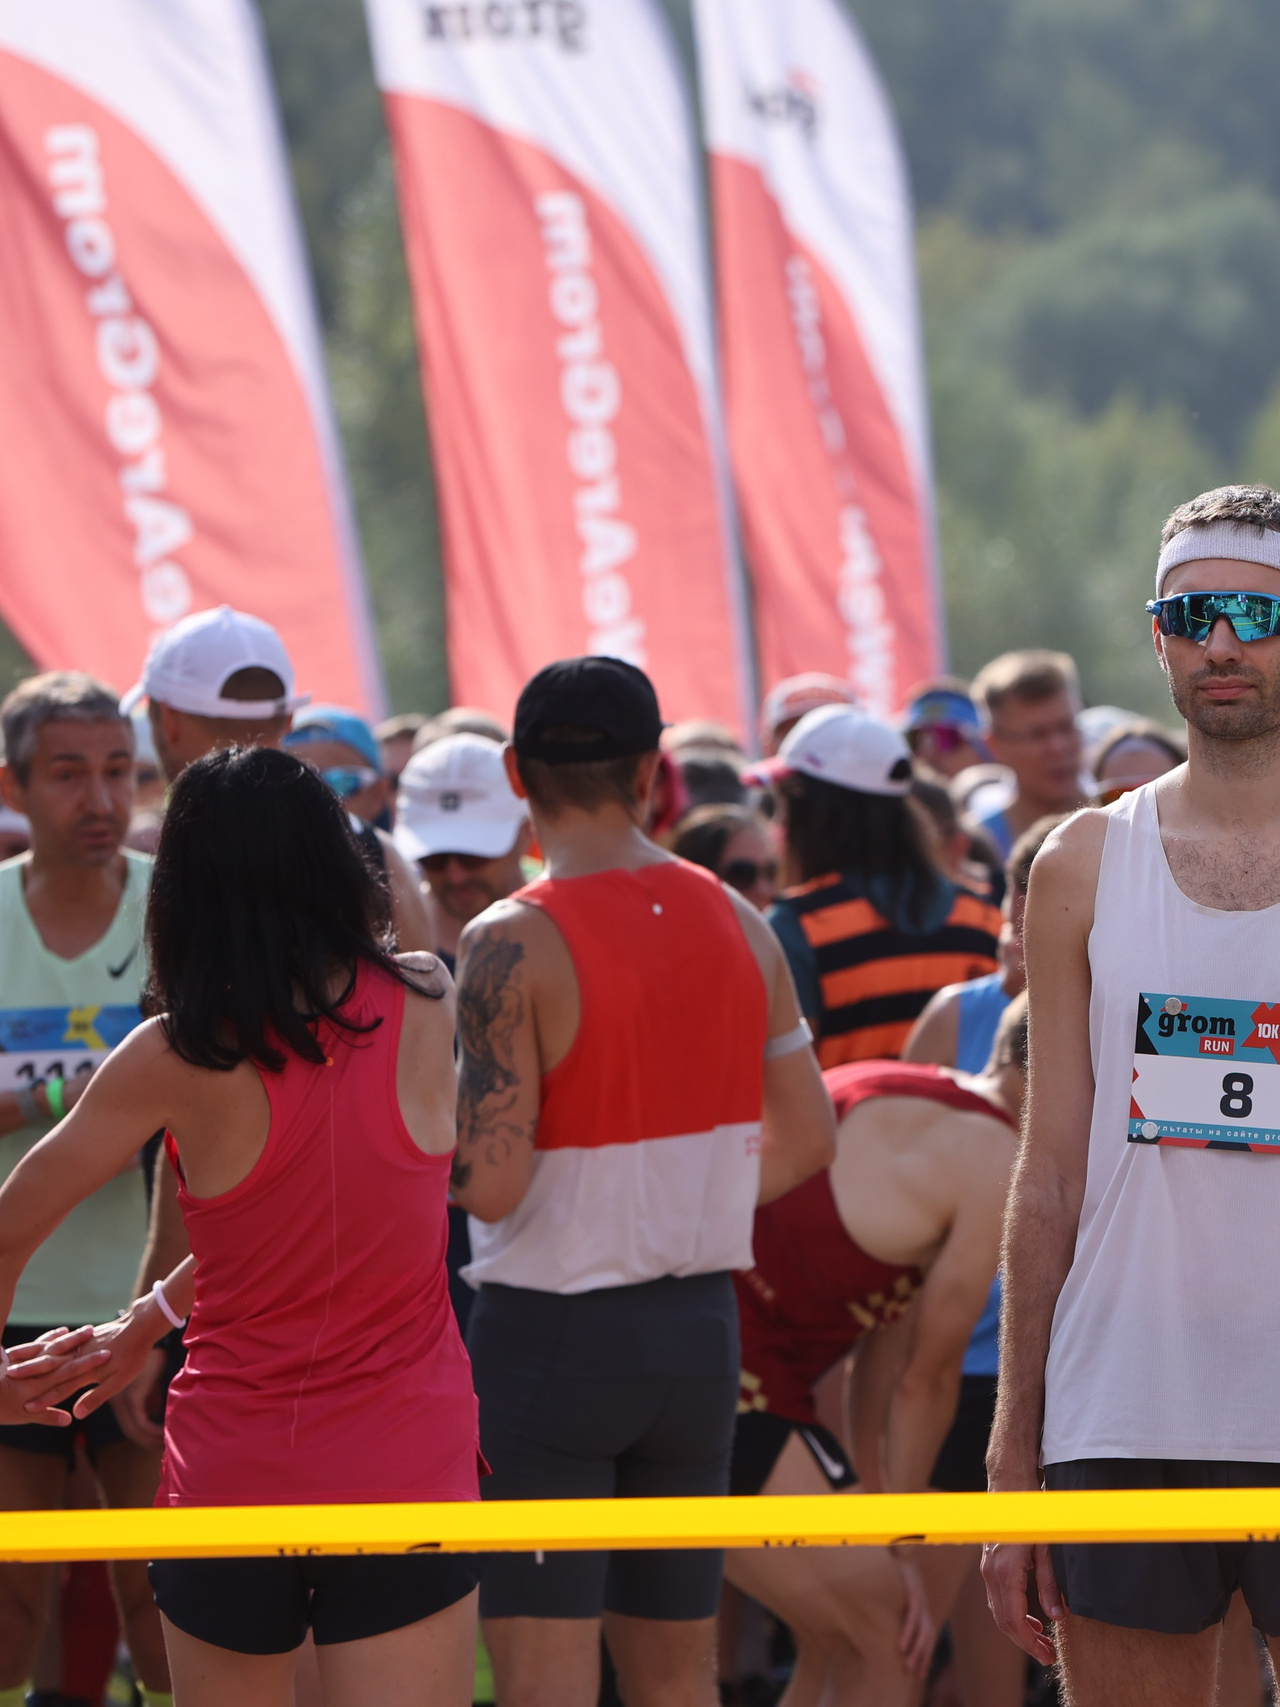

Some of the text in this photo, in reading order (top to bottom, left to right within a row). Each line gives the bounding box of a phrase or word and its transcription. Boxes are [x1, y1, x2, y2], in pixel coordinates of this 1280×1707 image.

[1158, 1012, 1235, 1037] grom
[1258, 1023, 1280, 1039] 10K
[1204, 1039, 1230, 1052] RUN
[1219, 1072, 1254, 1118] 8
[1226, 1130, 1259, 1139] сайте
